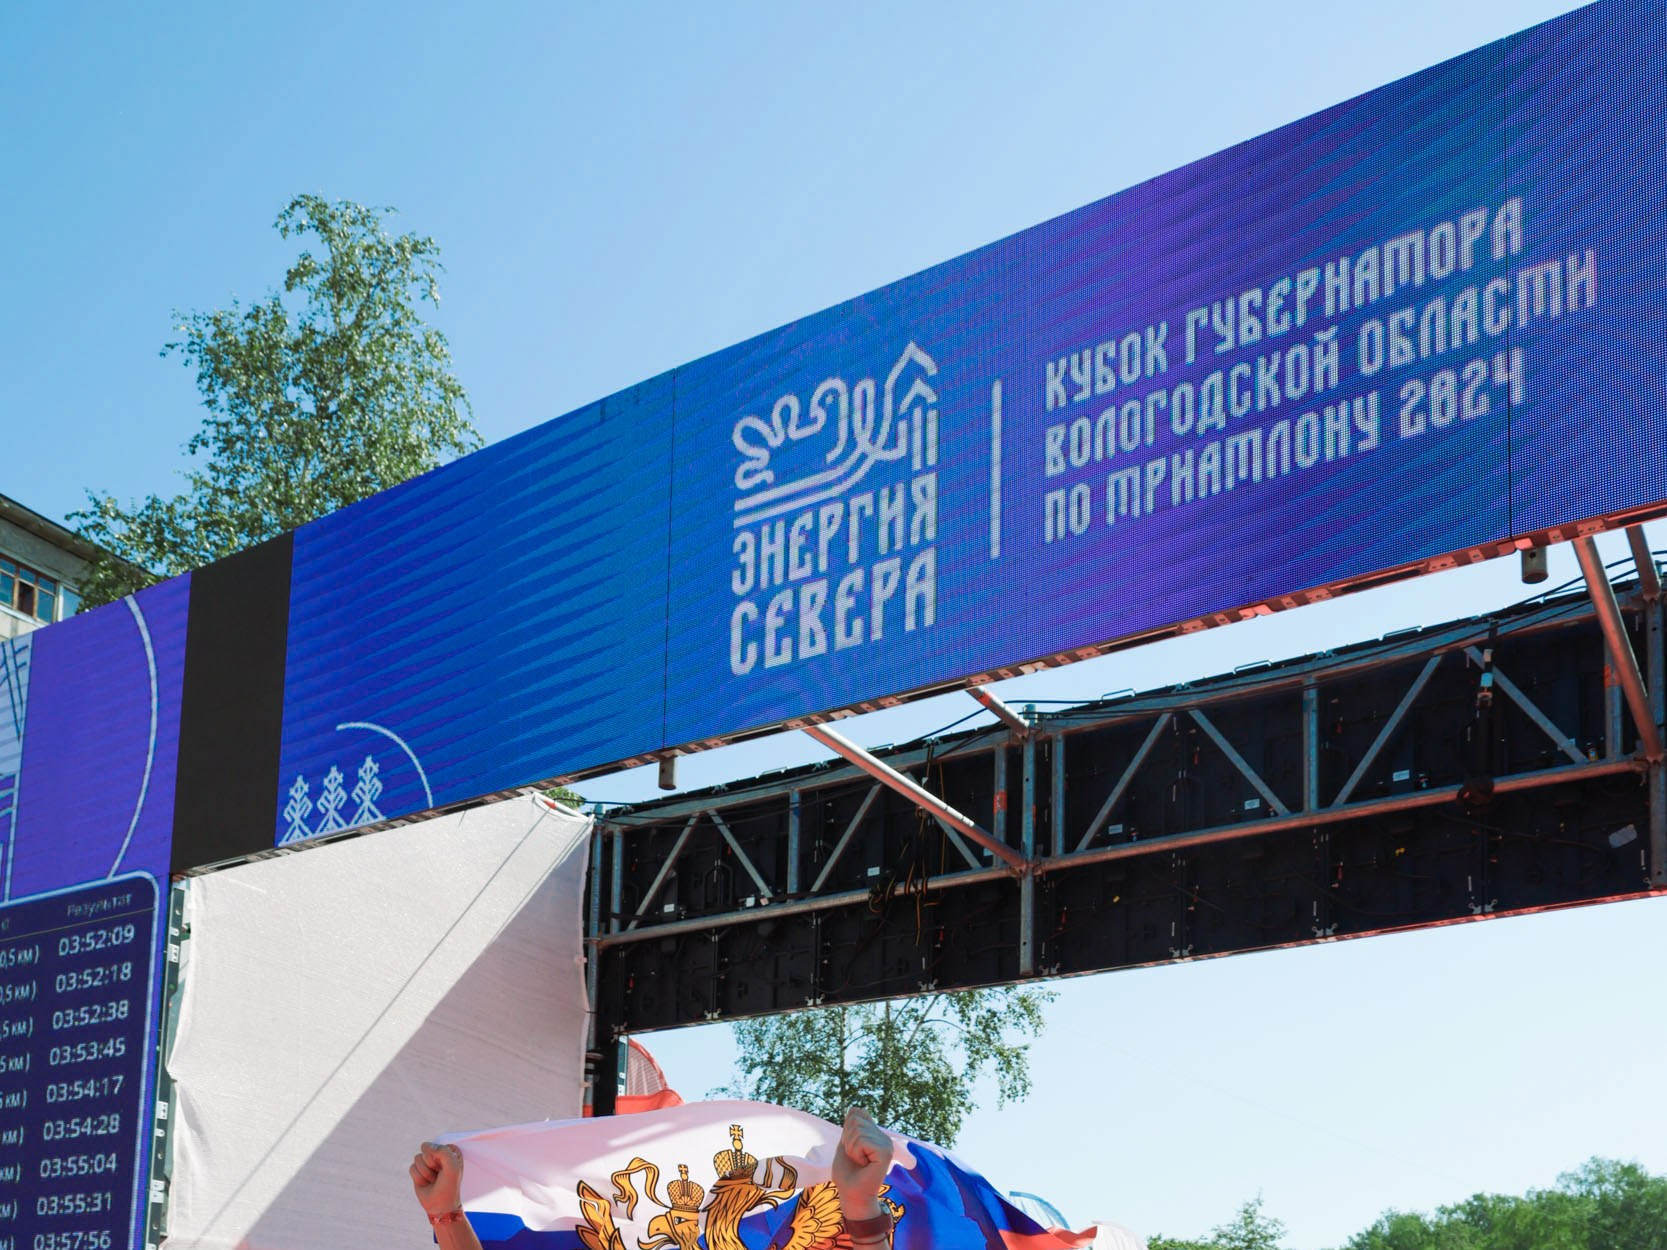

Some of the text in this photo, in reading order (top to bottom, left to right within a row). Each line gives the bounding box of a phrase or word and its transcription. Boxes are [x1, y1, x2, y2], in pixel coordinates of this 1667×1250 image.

[1045, 196, 1523, 411] КУБОК ГУБЕРНАТОРА
[1045, 249, 1598, 478] ВОЛОГОДСКОЙ ОБЛАСТИ
[1044, 349, 1525, 543] ПО ТРИАТЛОНУ 2024
[732, 472, 938, 596] ЭНЕРГИЯ
[730, 547, 937, 676] СЕВЕРА
[58, 924, 135, 957] 03:52:09
[55, 962, 132, 993] 03:52:18
[52, 1000, 129, 1030] 03:52:38
[49, 1038, 126, 1066] 03:53:45
[46, 1075, 124, 1103] 03:54:17
[43, 1113, 121, 1141] 03:54:28
[40, 1152, 117, 1178] 03:55:04
[36, 1192, 112, 1216] 03:55:31
